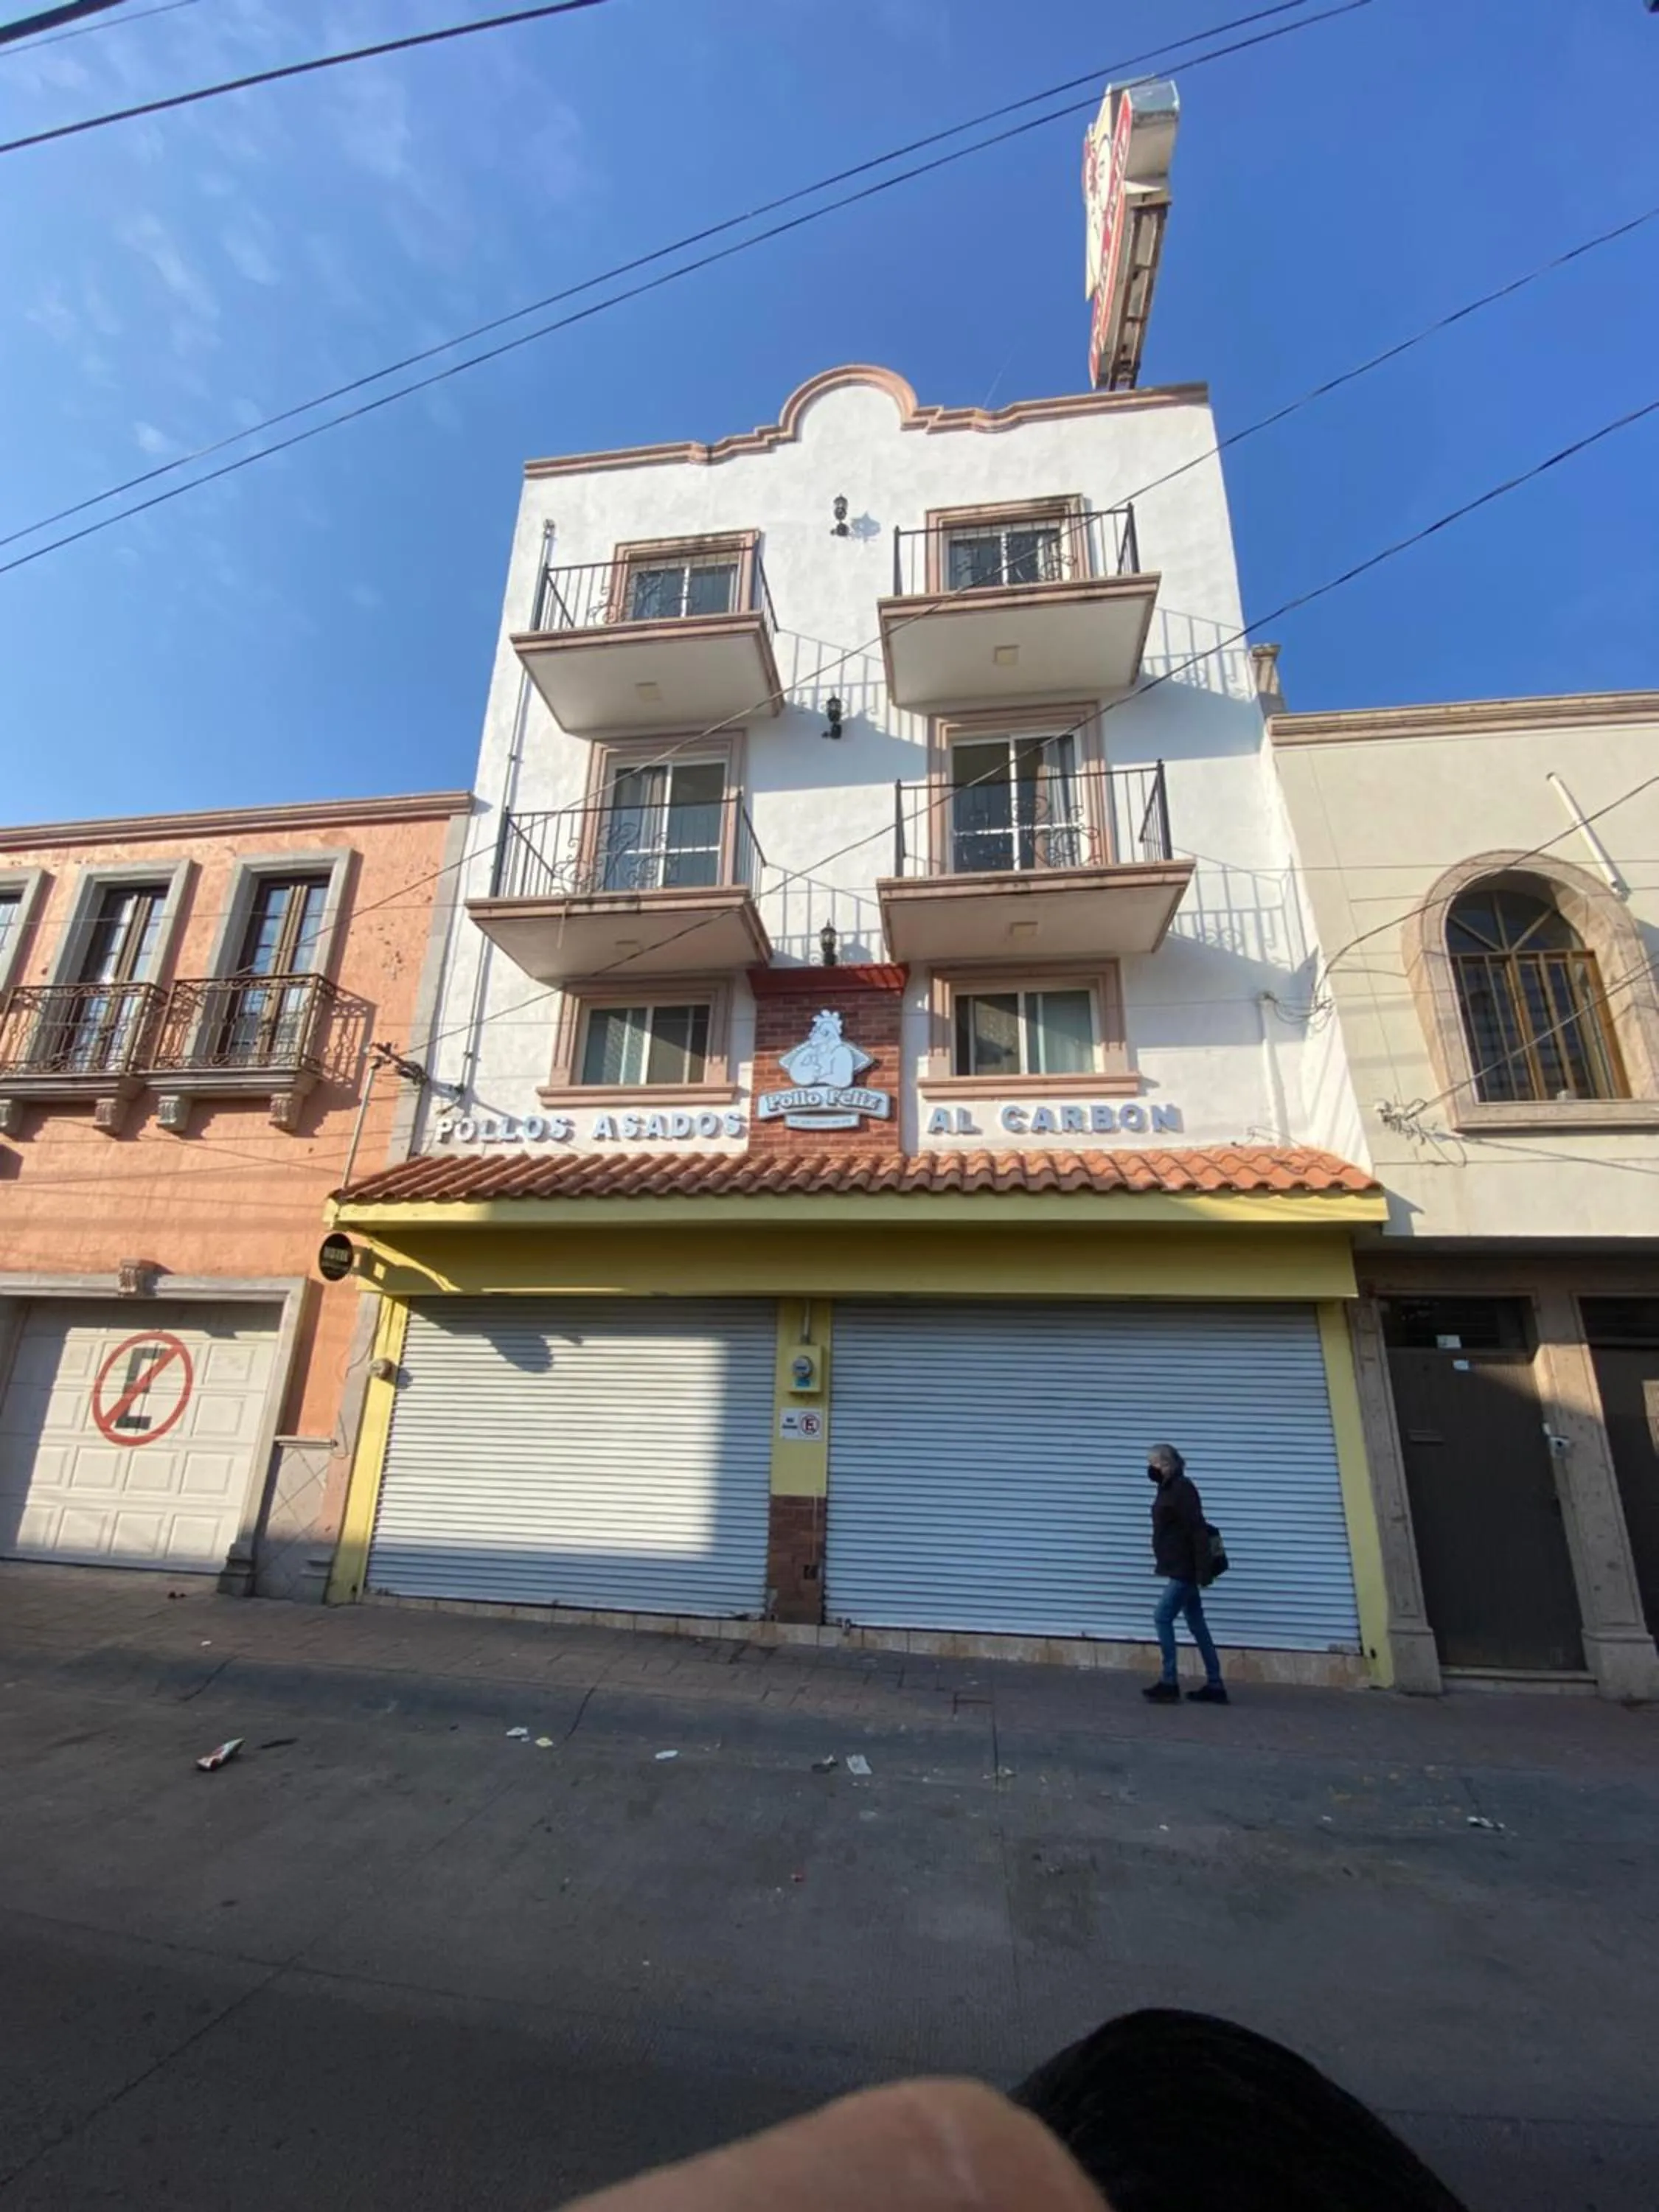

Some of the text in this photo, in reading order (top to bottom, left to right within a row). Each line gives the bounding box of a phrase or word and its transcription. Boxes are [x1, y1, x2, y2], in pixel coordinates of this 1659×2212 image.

[767, 1088, 881, 1111] Pollo Feliz
[437, 1112, 745, 1142] POLLOS ASADOS
[927, 1103, 1183, 1135] AL CARBON
